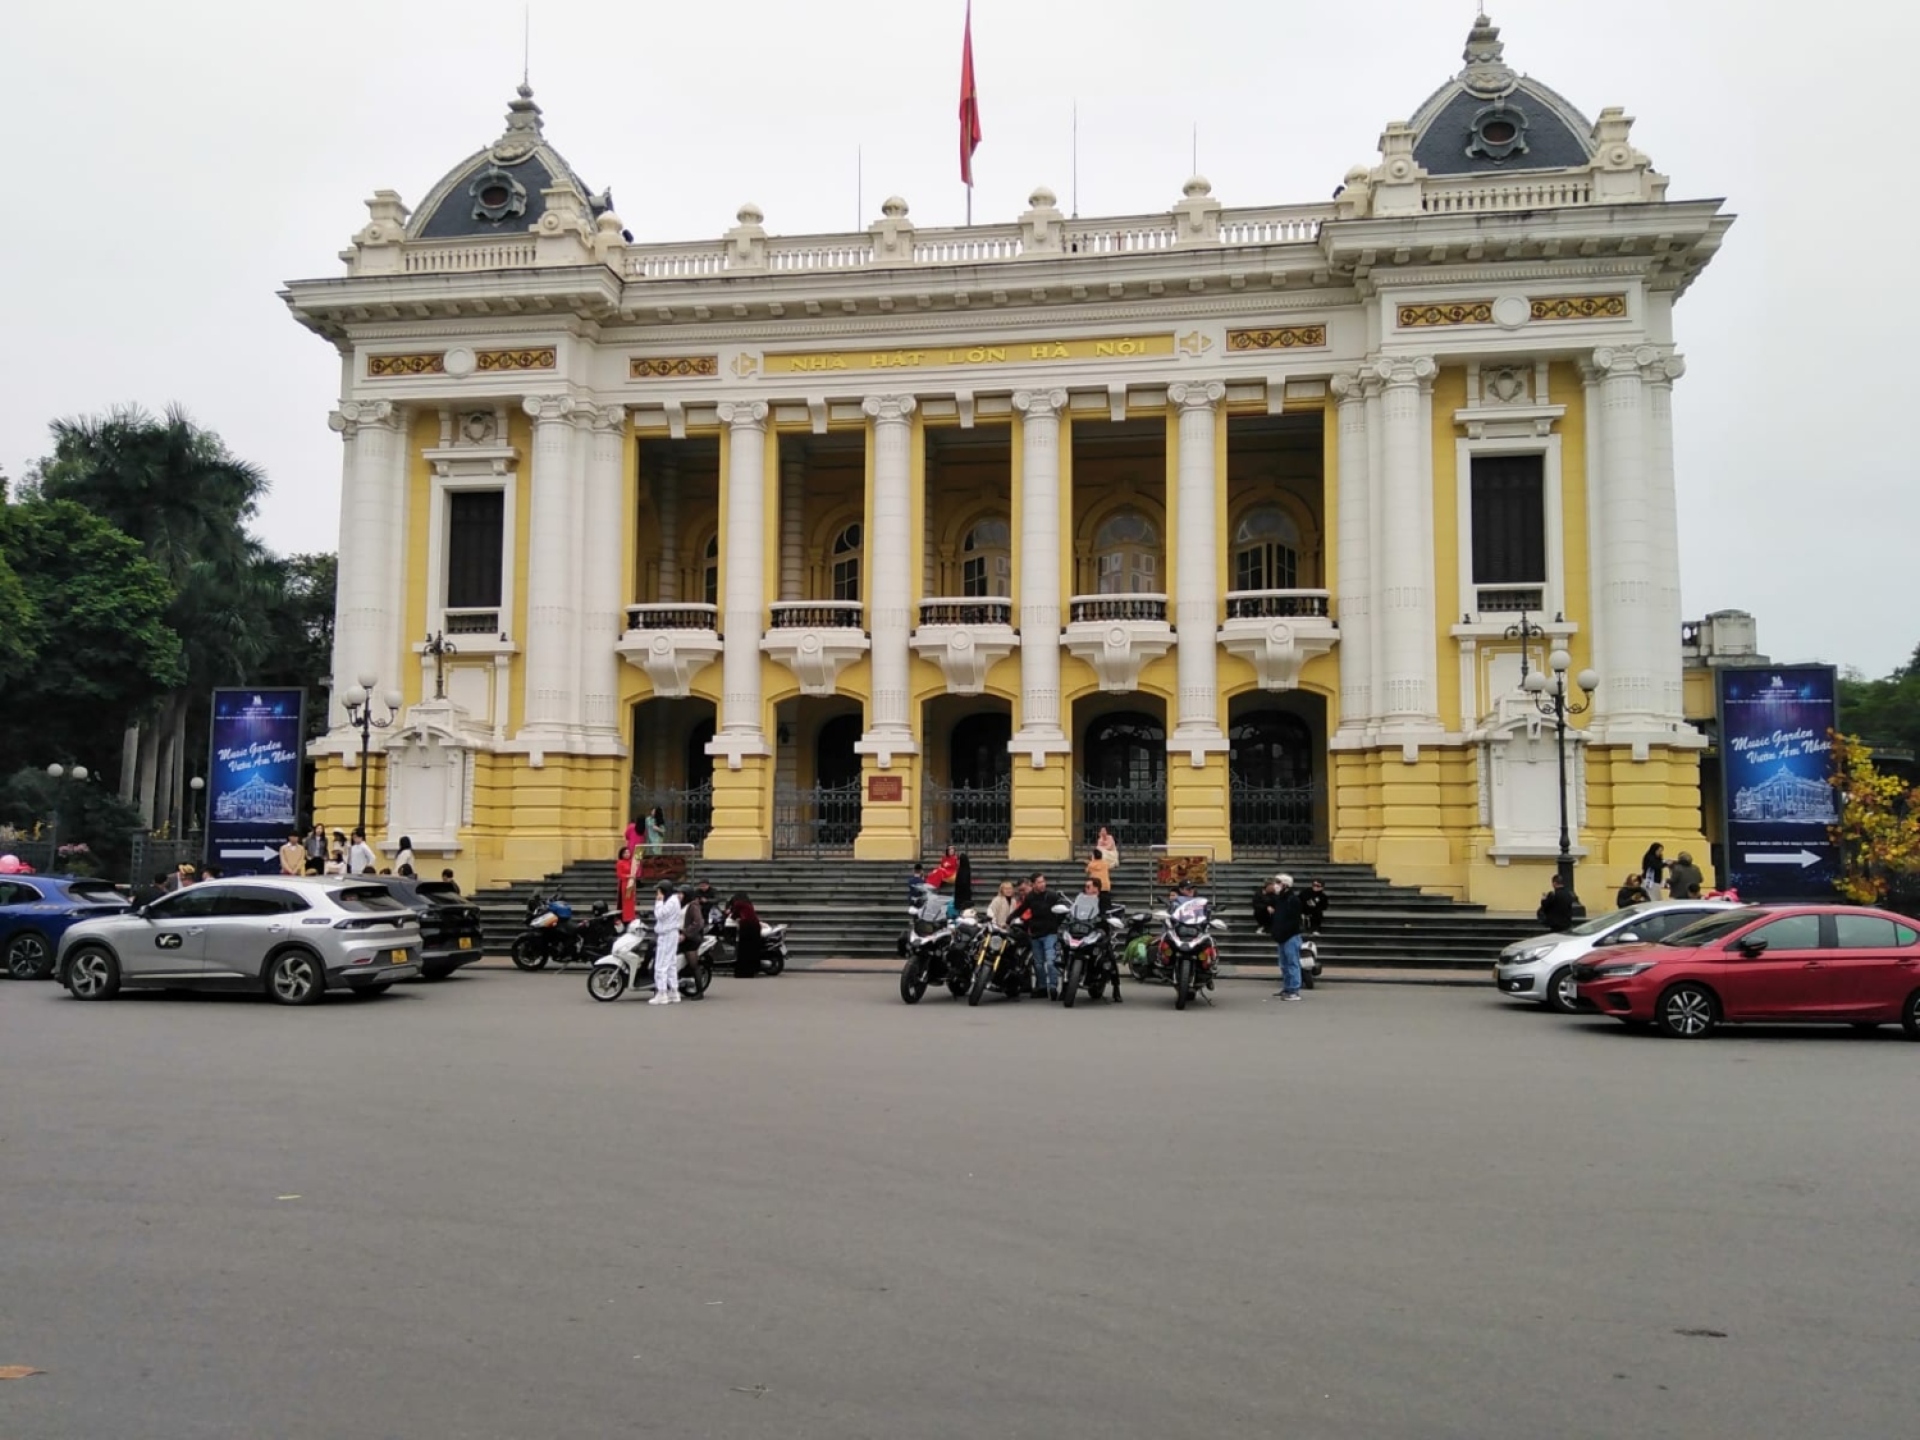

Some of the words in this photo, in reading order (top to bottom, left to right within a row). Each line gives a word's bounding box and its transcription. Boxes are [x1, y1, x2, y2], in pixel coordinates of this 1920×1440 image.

[870, 349, 925, 369] HÁT
[947, 346, 1007, 365] LỚN
[1030, 341, 1071, 359] HÀ
[1095, 337, 1147, 358] NỘI
[1772, 727, 1814, 748] Garden
